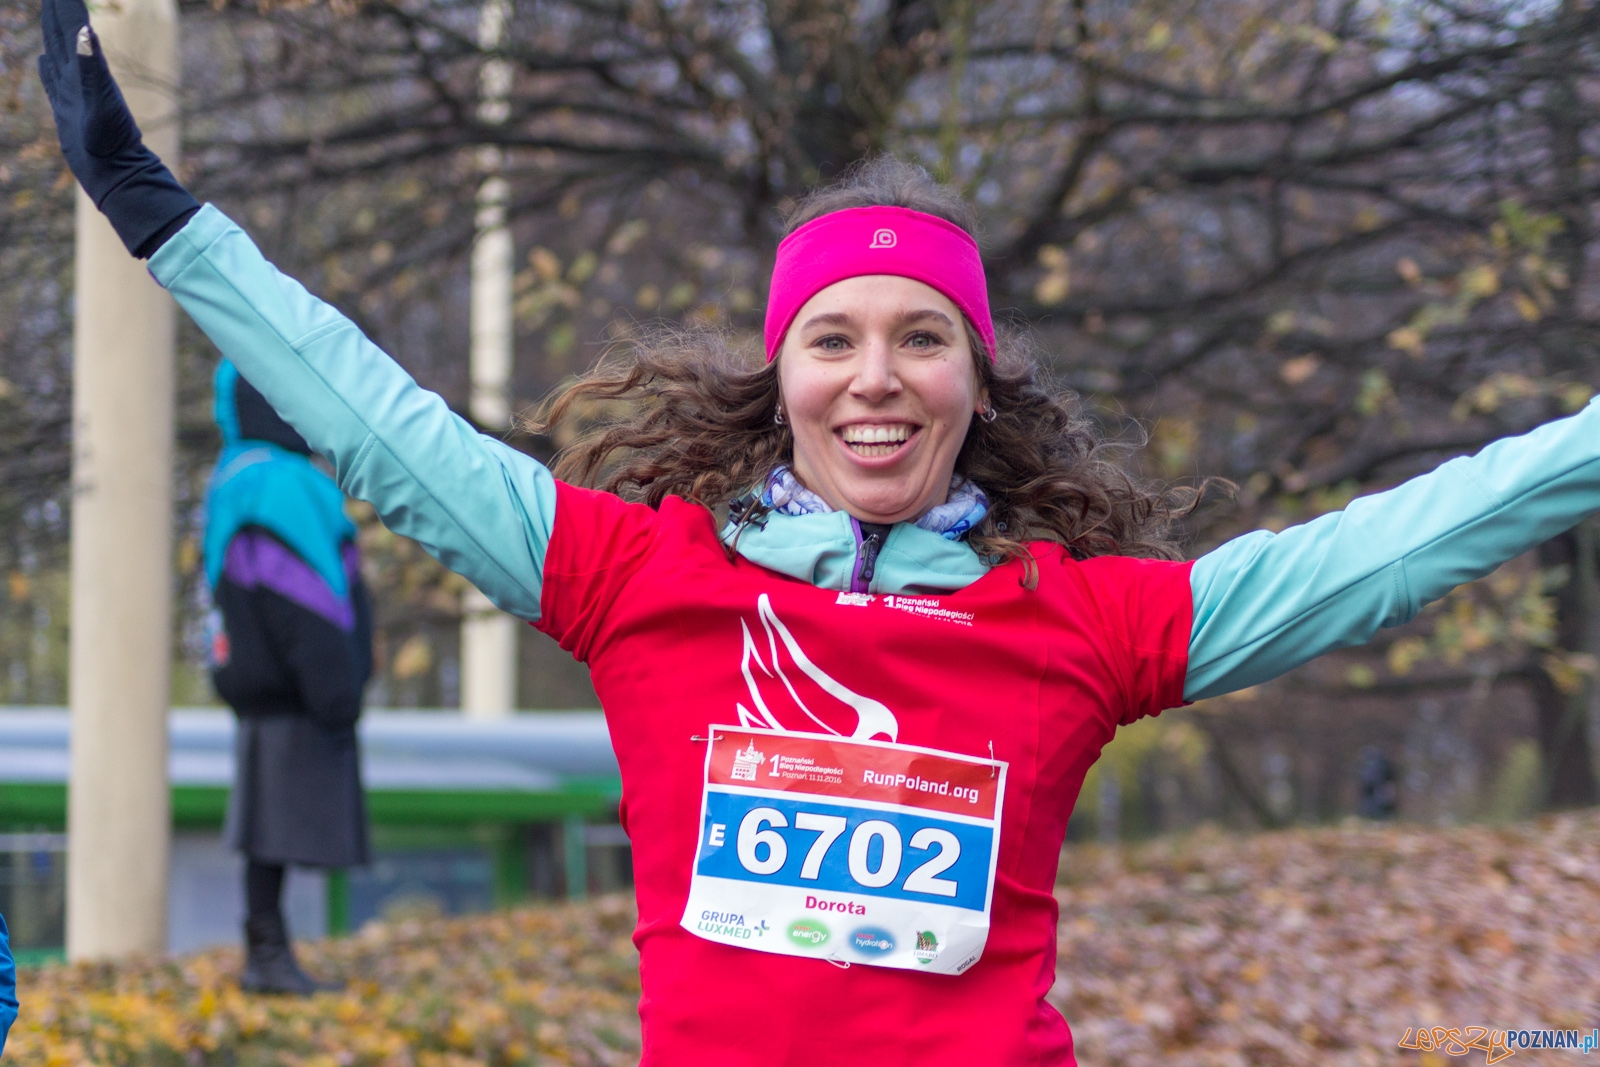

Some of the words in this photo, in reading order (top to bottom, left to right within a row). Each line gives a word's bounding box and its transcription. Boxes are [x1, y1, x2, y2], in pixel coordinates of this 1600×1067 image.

[883, 595, 894, 608] 1
[896, 596, 940, 608] Poznański
[768, 754, 780, 777] 1
[780, 755, 815, 765] Poznański
[779, 762, 794, 771] Bieg
[794, 764, 844, 776] Niepodległości
[809, 773, 843, 785] 11.11.2016
[862, 769, 979, 804] RunPoland.org
[708, 823, 726, 847] E
[736, 806, 961, 898] 6702
[805, 895, 867, 916] Dorota
[701, 910, 746, 927] GRUPA
[697, 921, 752, 940] LUXMED
[792, 930, 828, 944] energy
